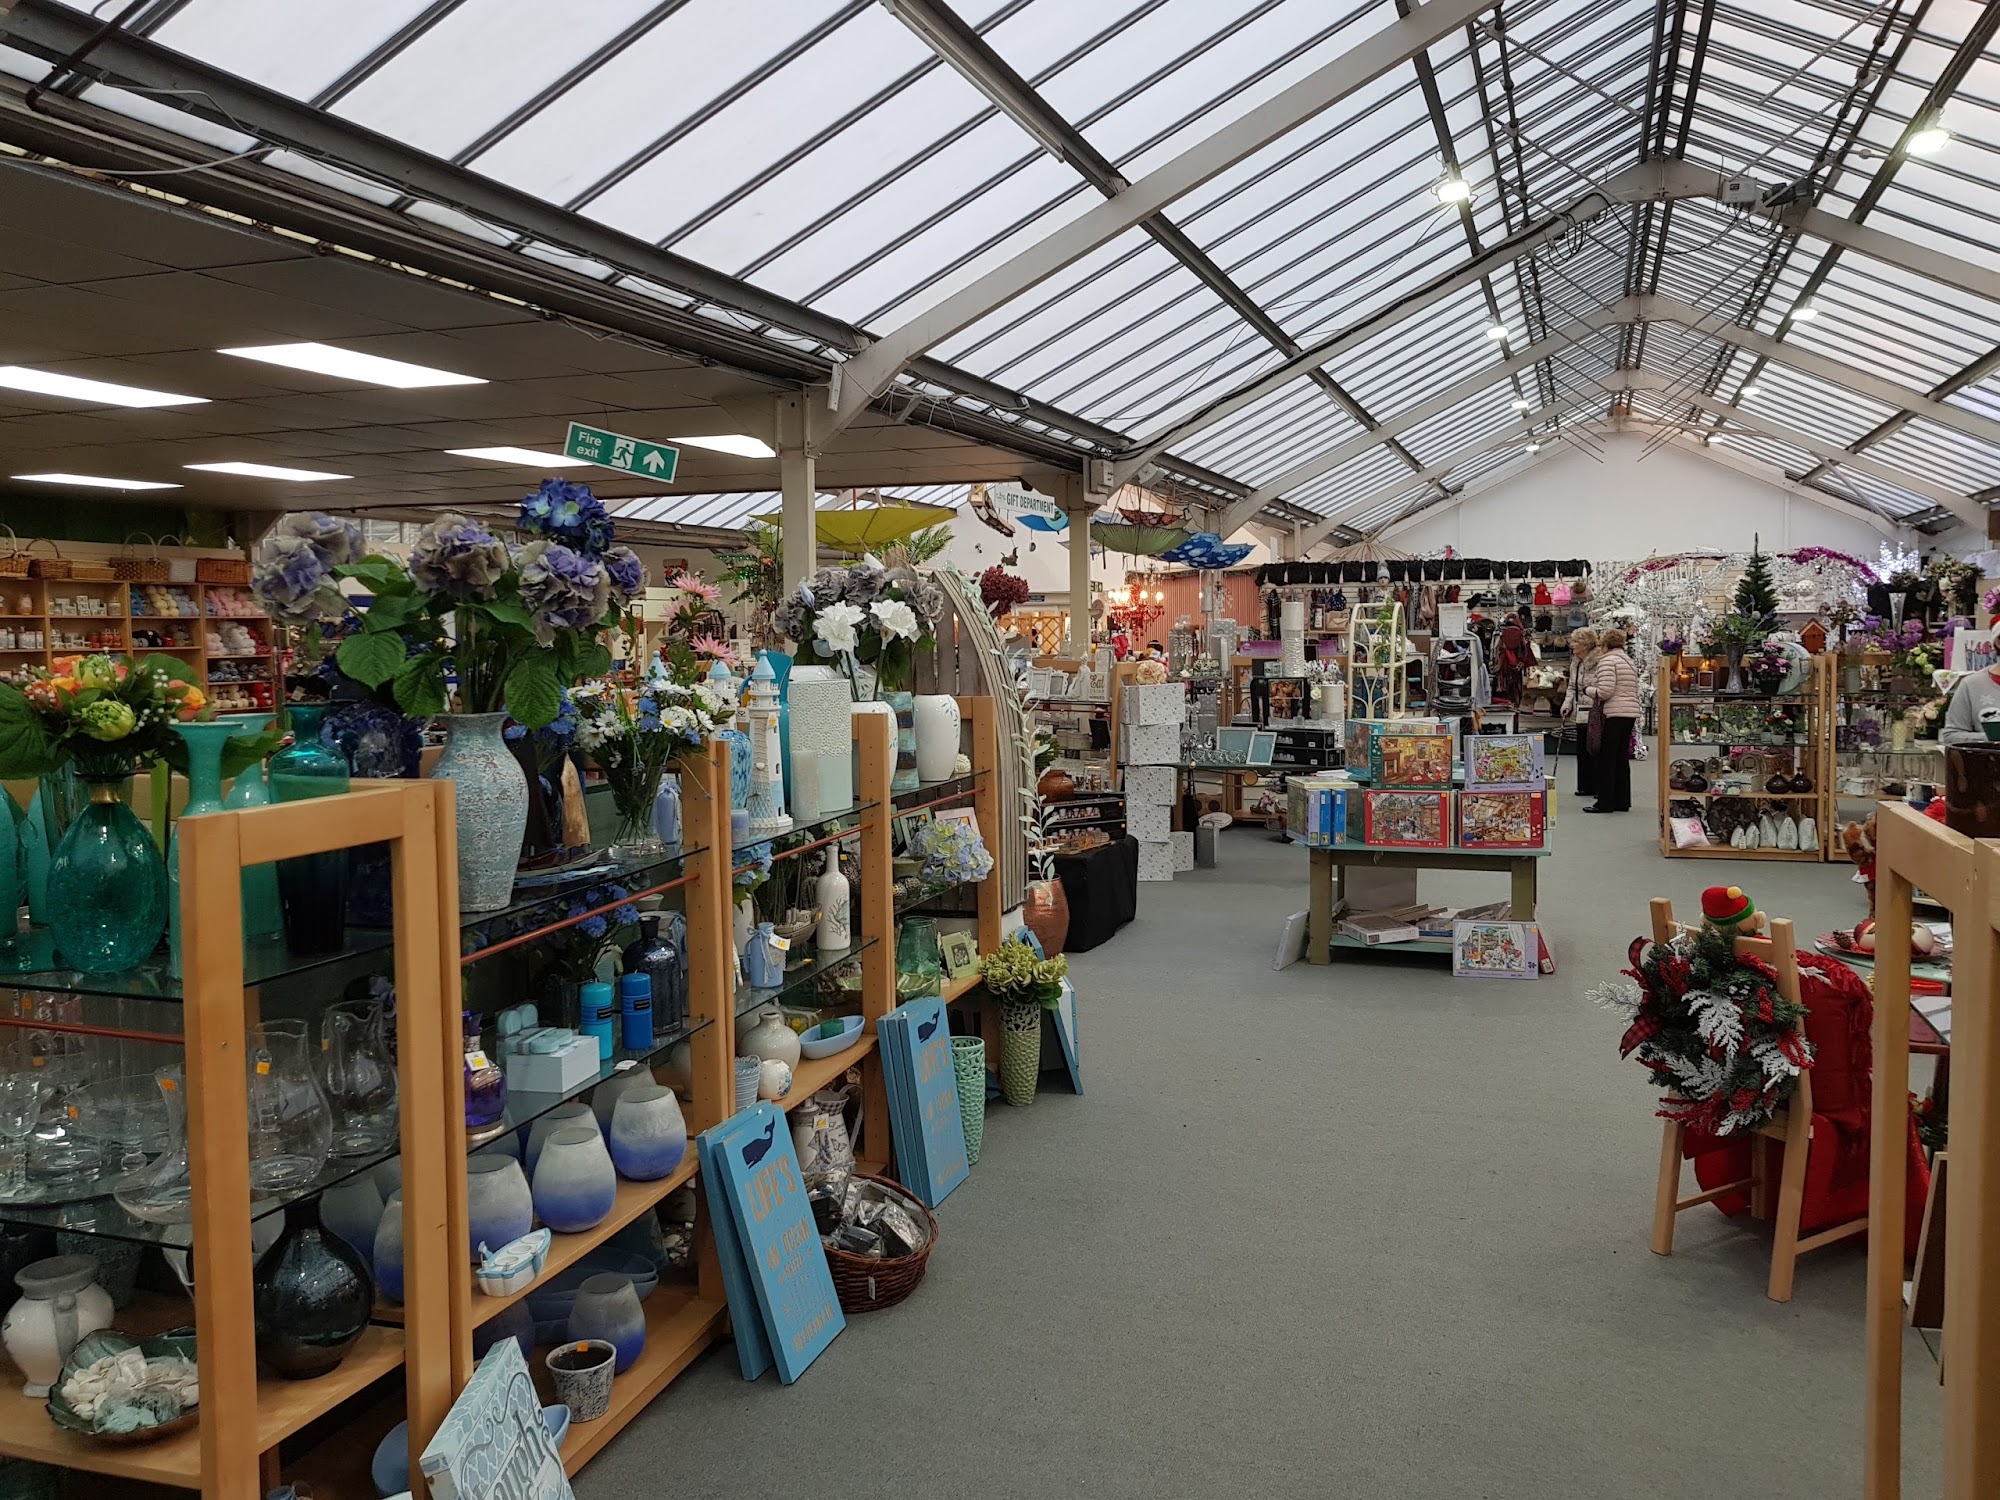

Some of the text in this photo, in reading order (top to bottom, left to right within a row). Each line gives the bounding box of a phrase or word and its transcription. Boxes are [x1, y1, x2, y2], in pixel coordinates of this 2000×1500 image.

[576, 445, 599, 459] exit
[578, 431, 602, 446] Fire
[1006, 493, 1018, 507] GIFT
[1020, 496, 1053, 513] DEPARTMENT
[918, 1036, 948, 1085] LIFE'S
[746, 1155, 796, 1221] LIFE'S
[782, 1217, 810, 1255] OCEAN
